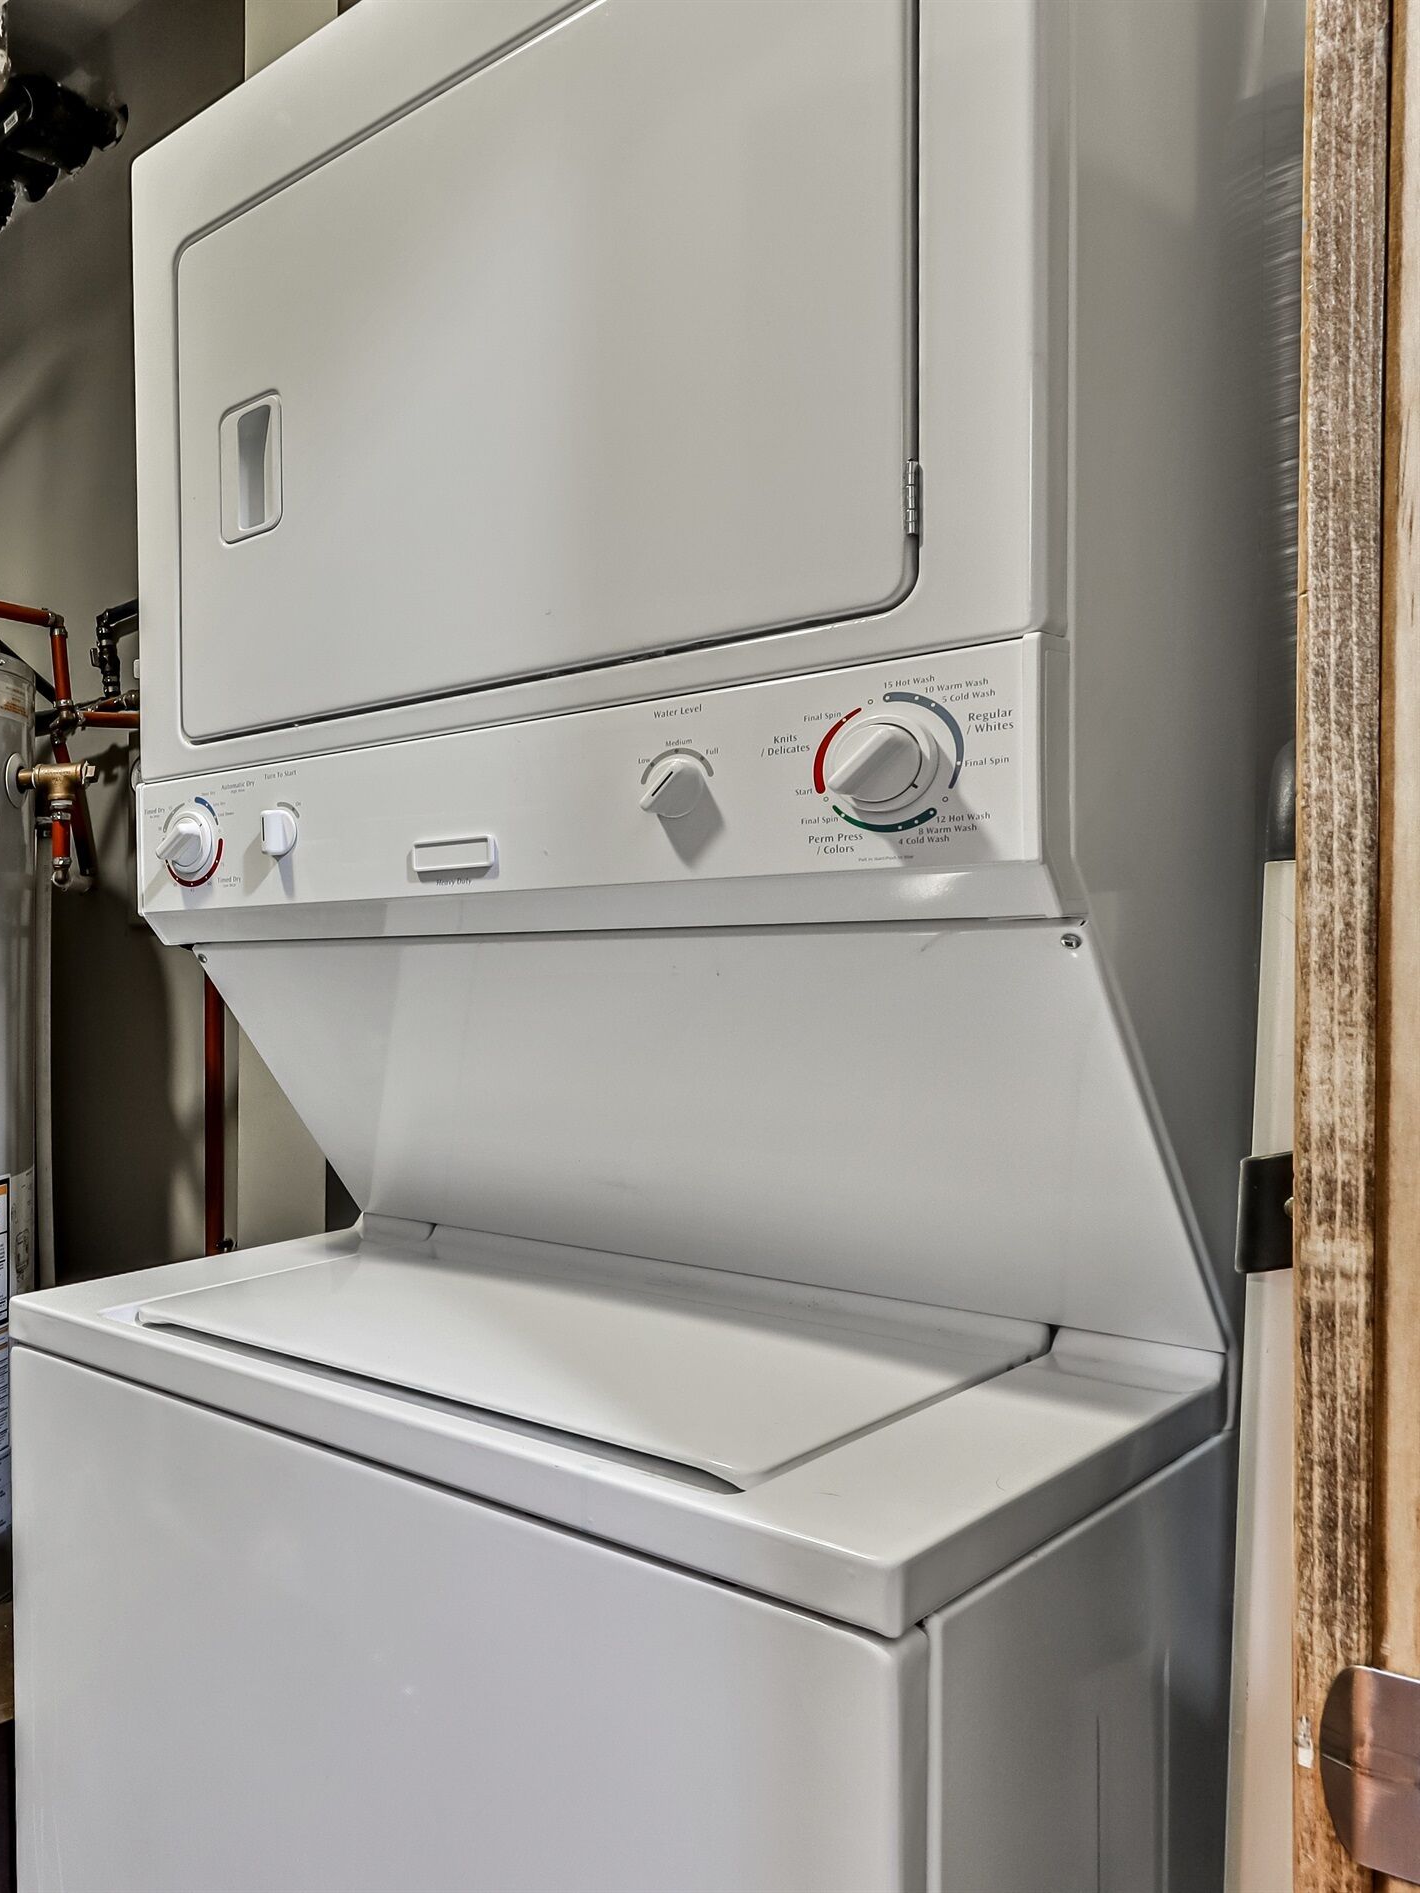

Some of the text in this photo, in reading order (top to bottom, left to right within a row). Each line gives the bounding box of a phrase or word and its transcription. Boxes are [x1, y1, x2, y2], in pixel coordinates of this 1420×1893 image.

[883, 675, 935, 689] 15 Hot Wash
[937, 683, 963, 692] Warm
[965, 678, 989, 688] Wash
[942, 689, 996, 703] 5 Cold Wash
[653, 704, 702, 720] Water Level
[803, 711, 842, 722] Final Spin
[968, 709, 1013, 723] Regular
[975, 722, 1014, 733] Whites
[665, 738, 693, 747] Medium
[773, 734, 798, 744] Knits
[767, 744, 811, 756] Delicates
[964, 756, 1010, 768] Final Spin
[221, 780, 255, 790] Automatic Dry
[795, 788, 813, 796] Start
[800, 815, 839, 825] Final Spin
[936, 812, 991, 824] 12 Hot Wash
[918, 823, 977, 835] 8 Warm Wash
[808, 833, 863, 844] Perm Press
[906, 836, 924, 845] Cold
[926, 834, 950, 843] Wash
[823, 845, 855, 854] Colors
